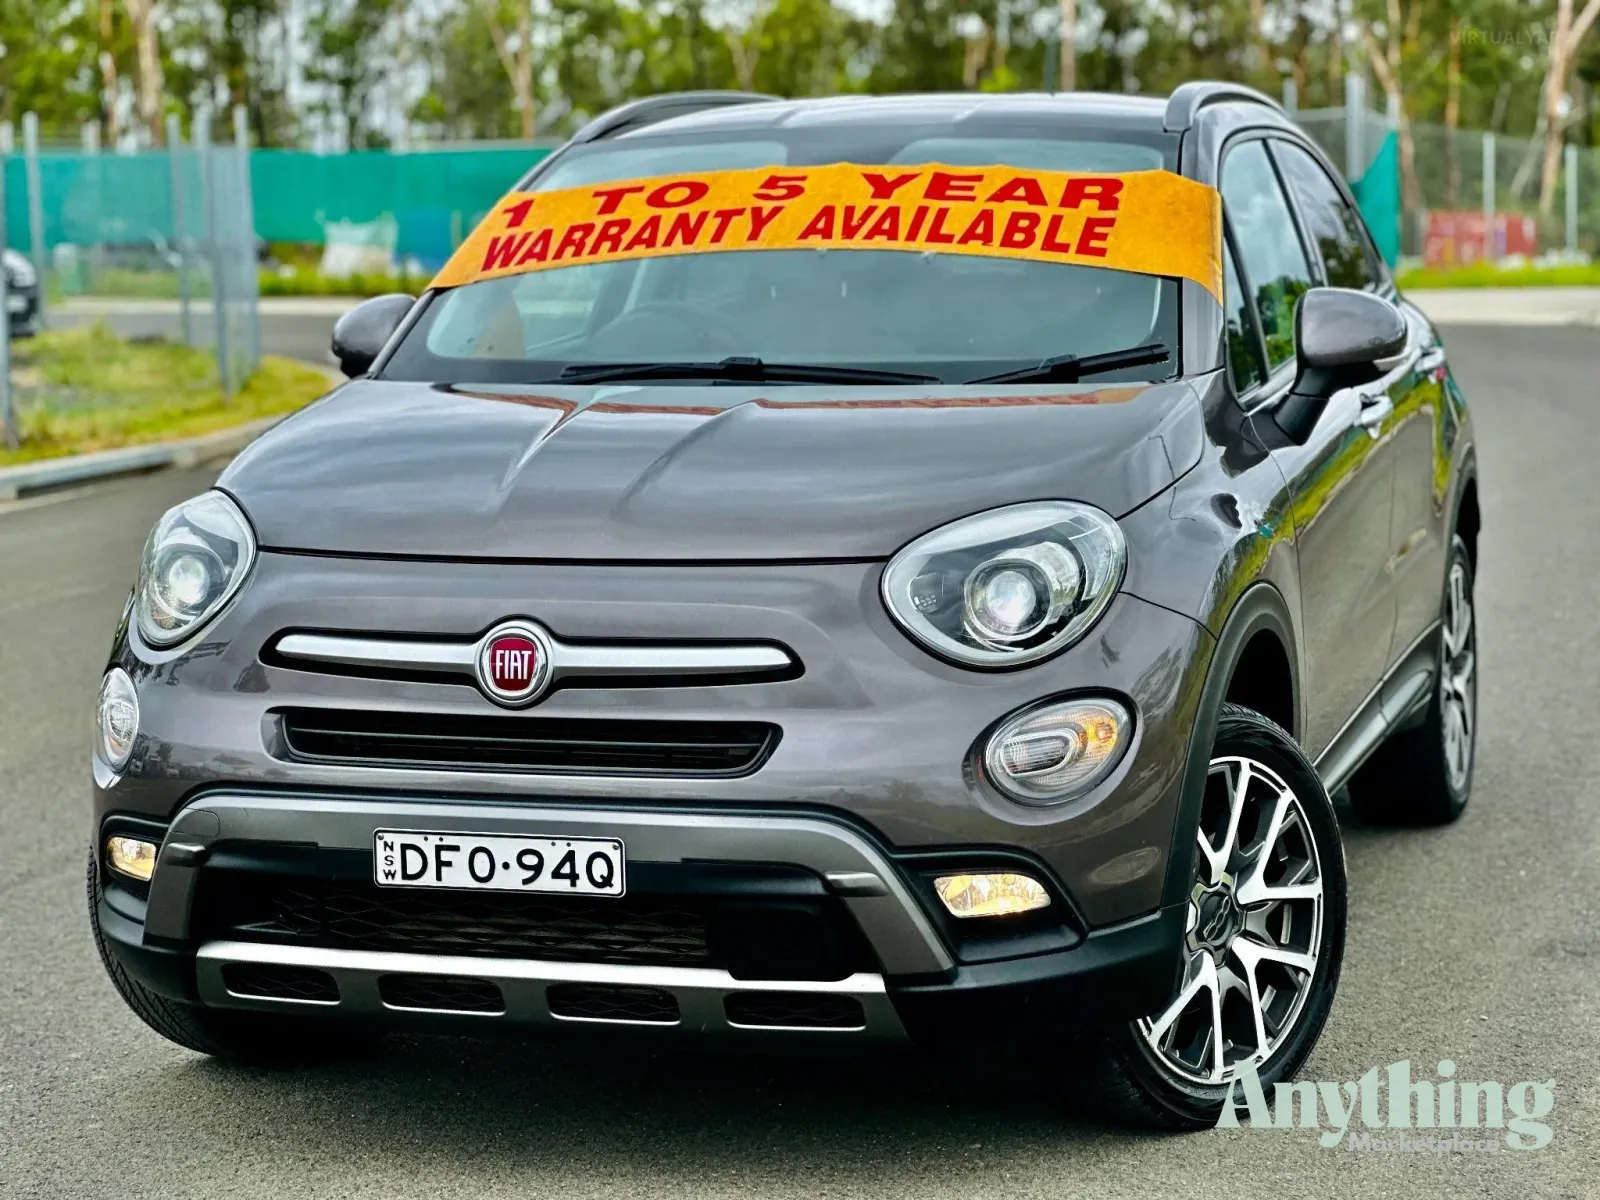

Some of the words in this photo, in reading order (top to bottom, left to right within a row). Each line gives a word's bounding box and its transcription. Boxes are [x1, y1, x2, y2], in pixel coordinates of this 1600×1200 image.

[502, 199, 535, 228] 1
[592, 182, 709, 215] TO
[753, 175, 808, 201] 5
[861, 171, 1125, 211] YEAR
[480, 205, 785, 272] WARRANTY
[796, 204, 1117, 258] AVAILABLE
[495, 649, 532, 680] FIAT
[383, 840, 397, 881] NSW
